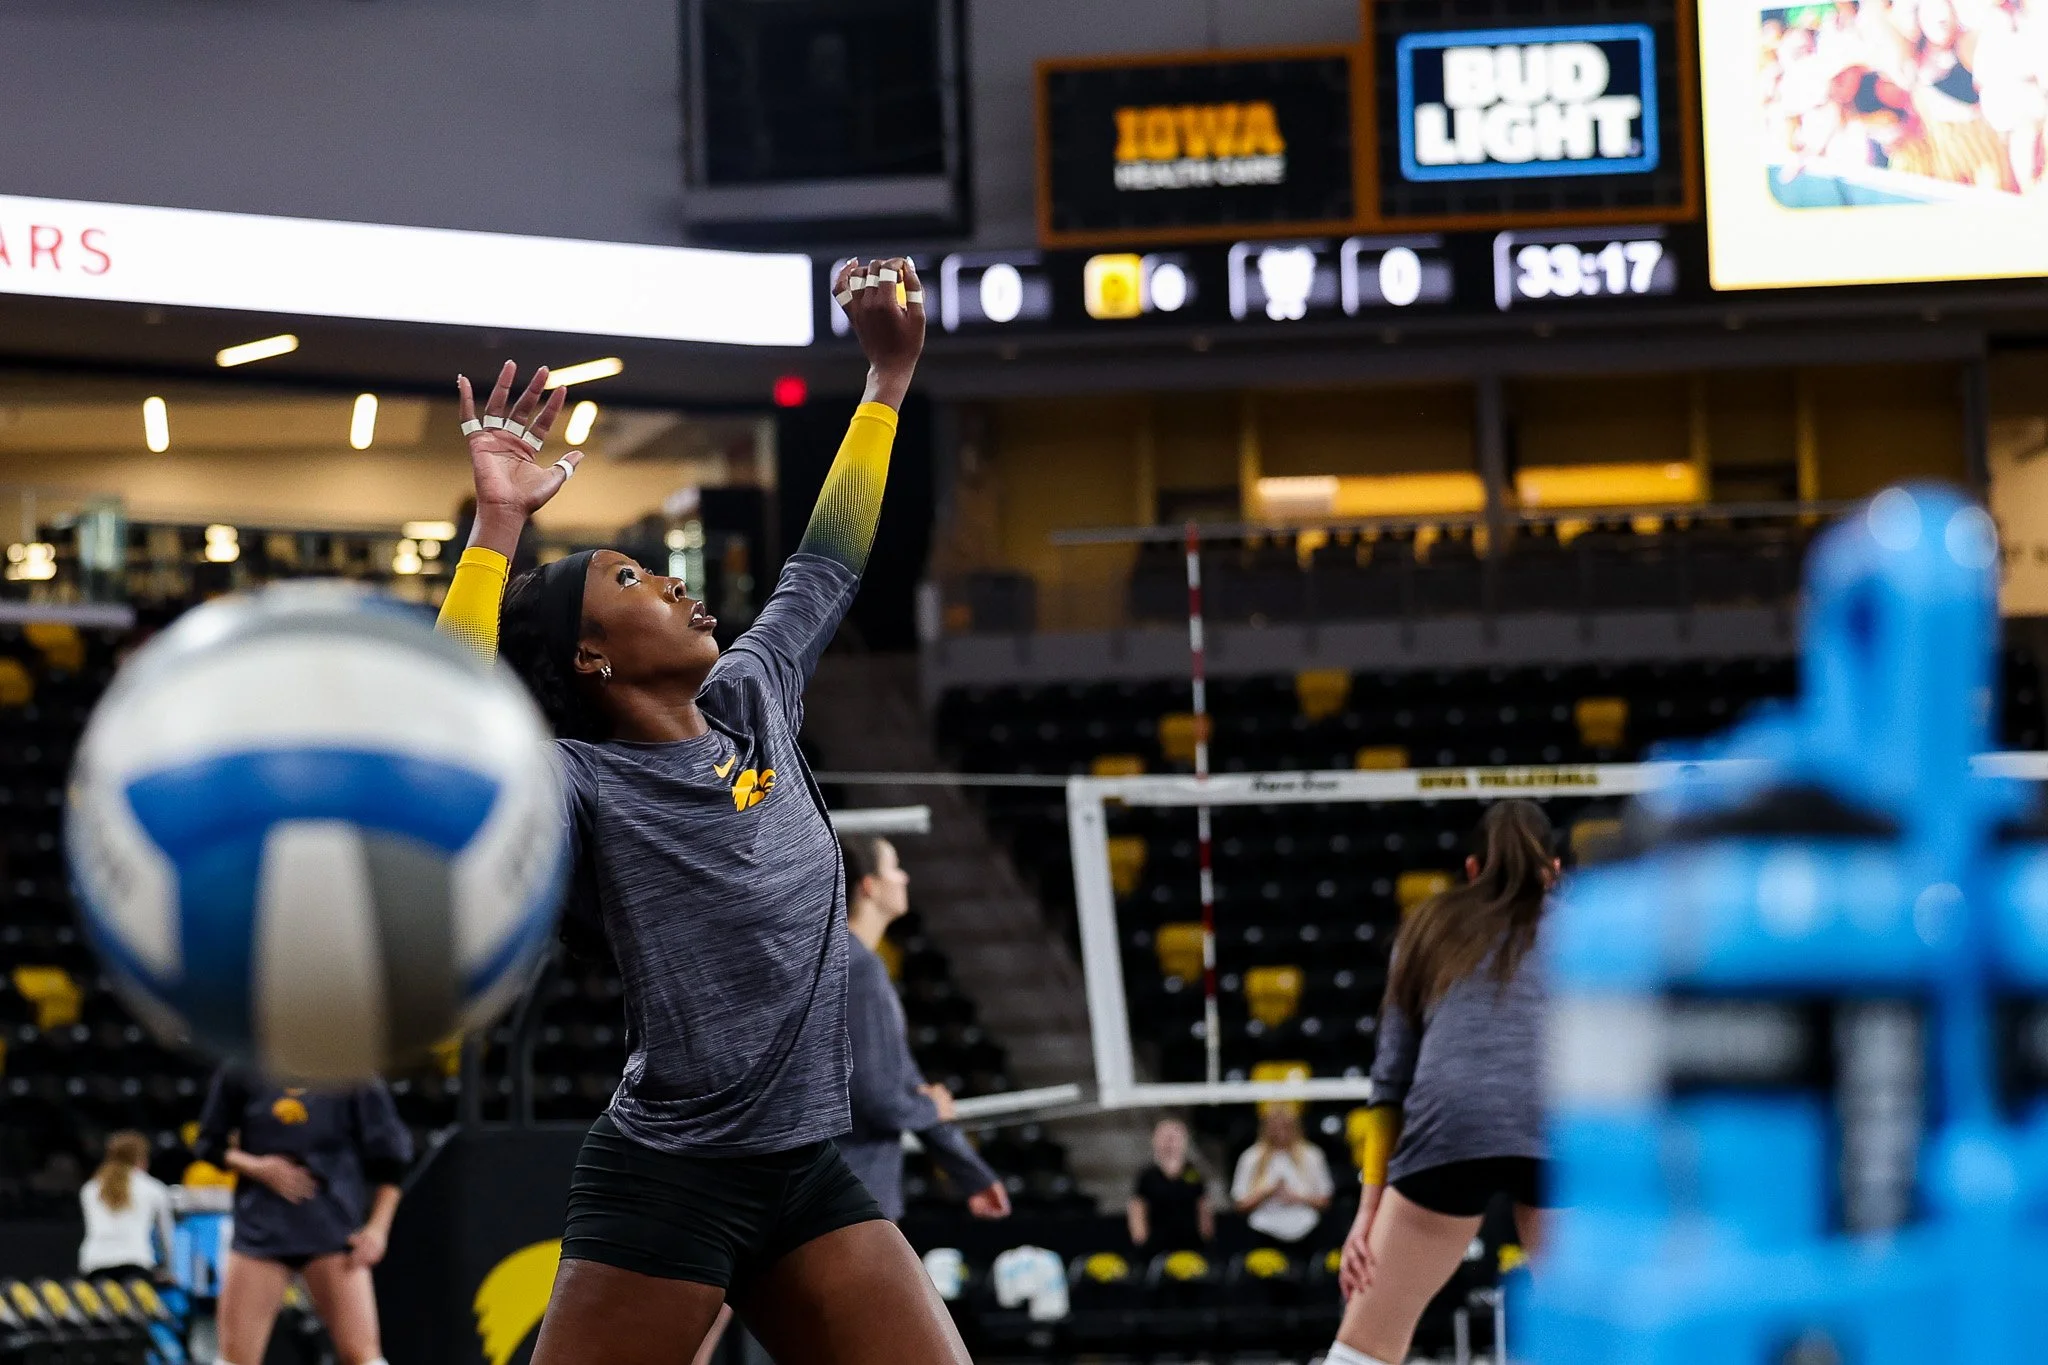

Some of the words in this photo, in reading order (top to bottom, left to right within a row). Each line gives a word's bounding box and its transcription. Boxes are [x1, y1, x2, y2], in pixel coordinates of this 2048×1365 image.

[1443, 43, 1610, 109] BUD
[1115, 104, 1284, 160] IOWA
[1415, 94, 1641, 165] LIGHT
[980, 263, 1023, 322] 0
[1150, 263, 1187, 312] 0
[1379, 247, 1422, 305] 0
[1516, 241, 1662, 298] 33:17
